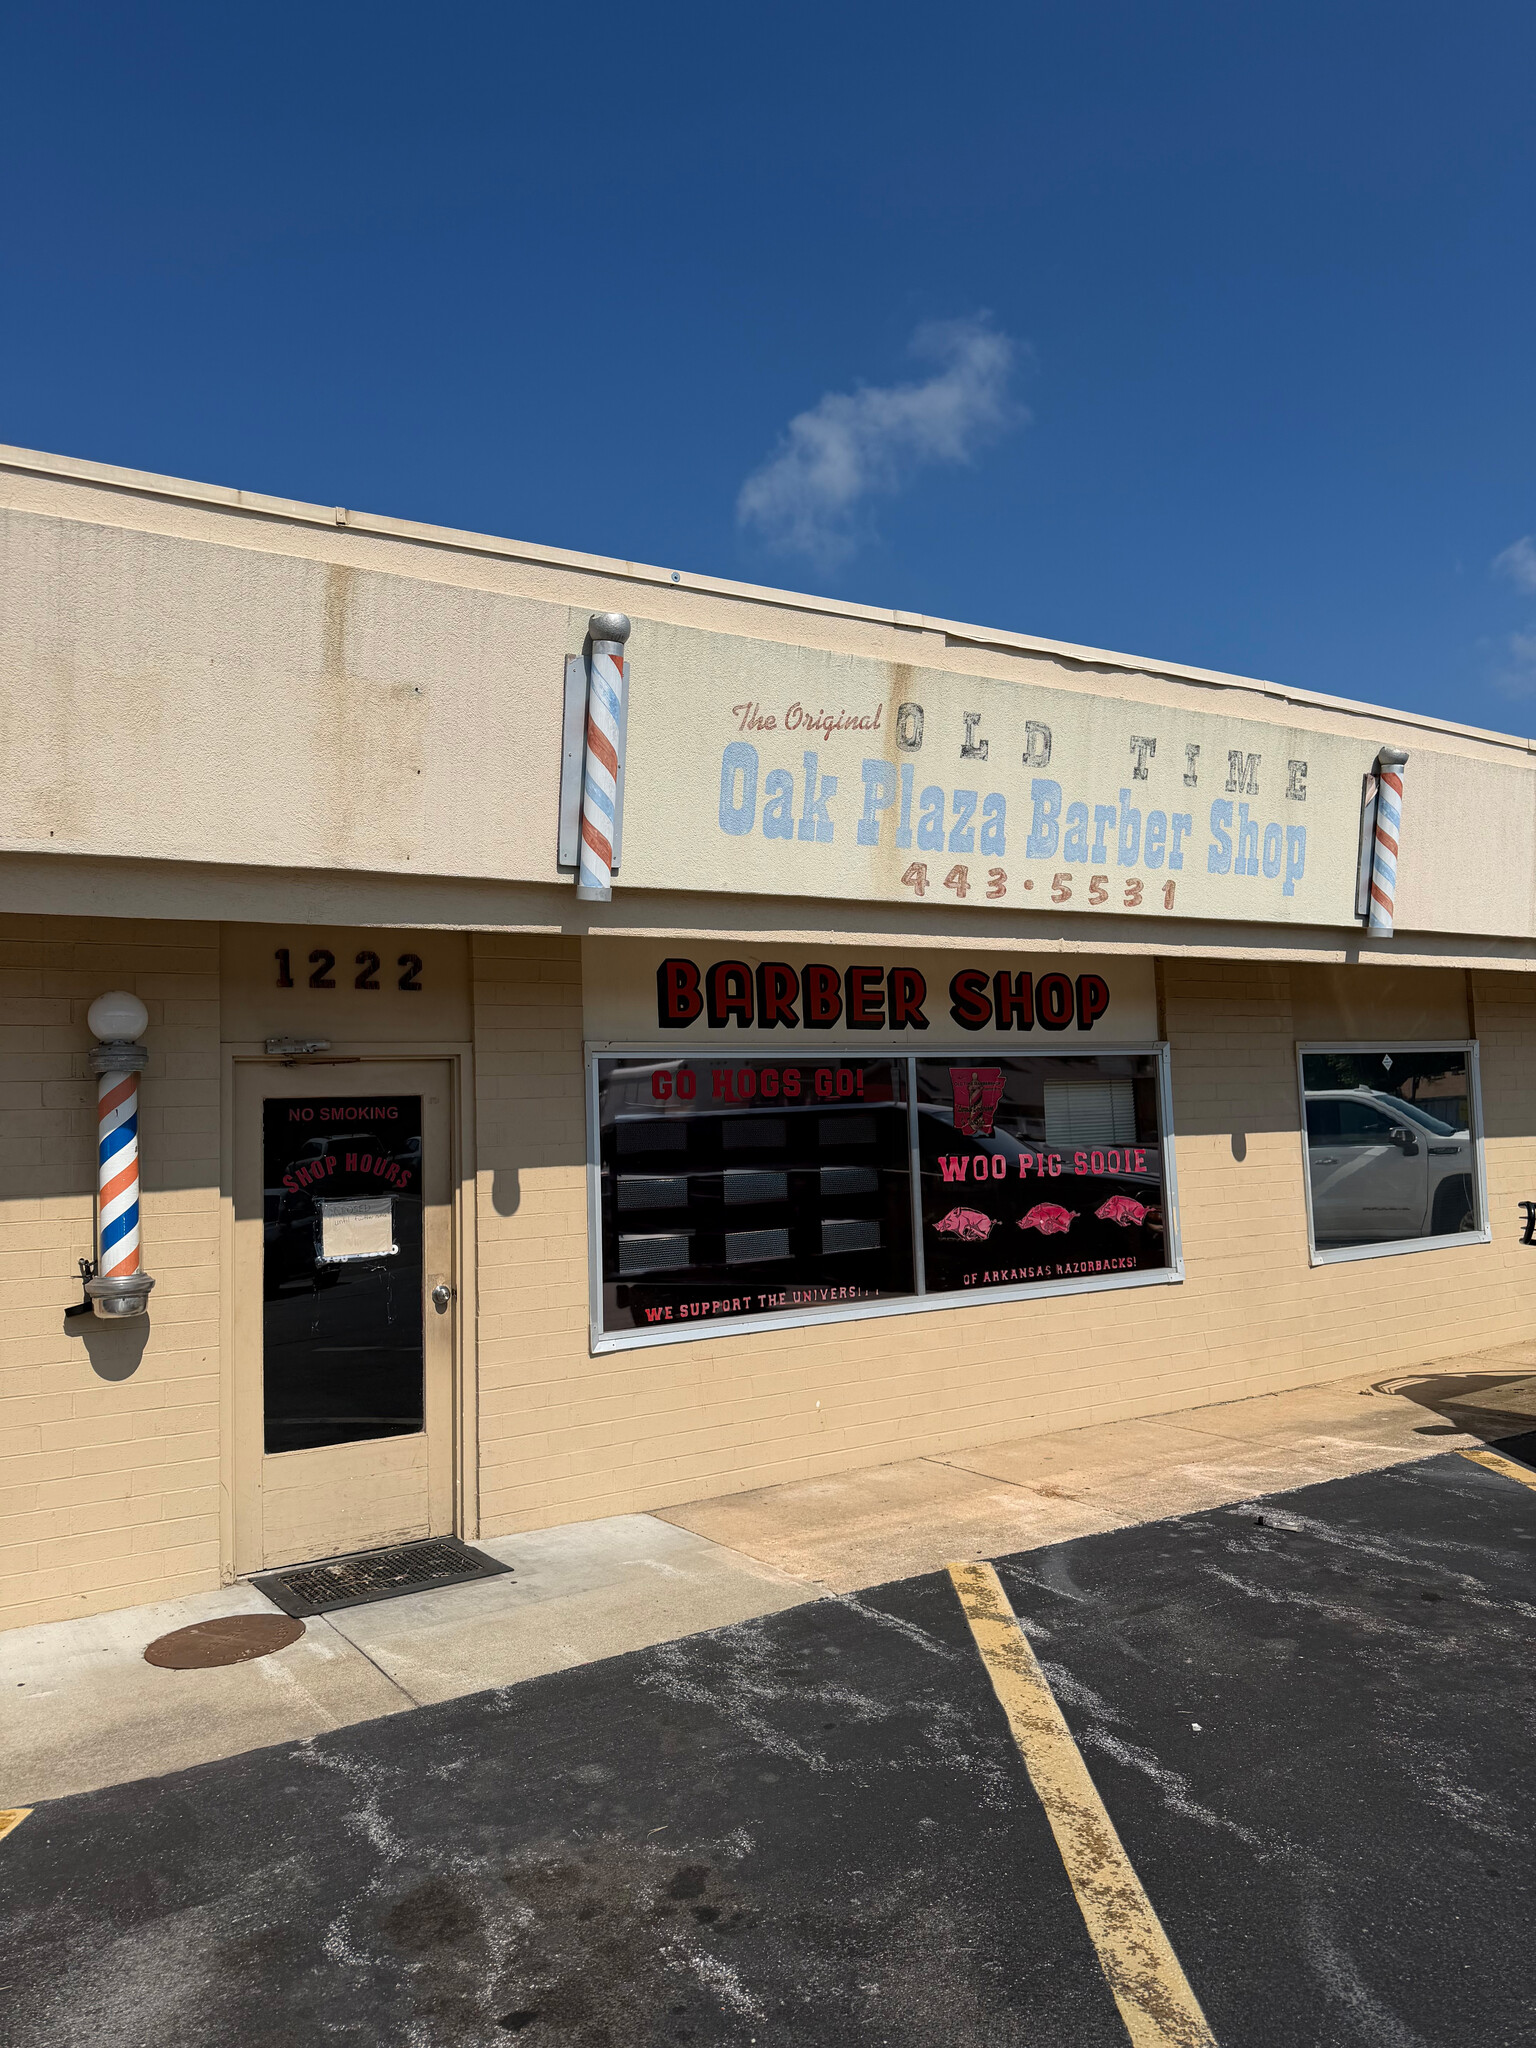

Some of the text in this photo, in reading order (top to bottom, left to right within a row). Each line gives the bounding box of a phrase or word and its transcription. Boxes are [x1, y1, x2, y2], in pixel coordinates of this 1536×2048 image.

[732, 701, 1308, 802] The Original OLD TIME
[719, 741, 1307, 897] Oak Plaza Barber Shop
[275, 948, 423, 991] 1222
[656, 957, 1111, 1031] BARBER SHOP
[652, 1068, 864, 1100] GO HOGS GO!
[289, 1106, 399, 1121] NO SMOKING
[283, 1153, 412, 1194] SHOP HOURS
[938, 1149, 1148, 1182] WOO PIG SOOIE
[963, 1256, 1137, 1286] OF ARKANSAS RAZORBACKS!
[645, 1306, 673, 1322] WE
[680, 1296, 752, 1318] SUPPORT
[758, 1292, 786, 1307] THE
